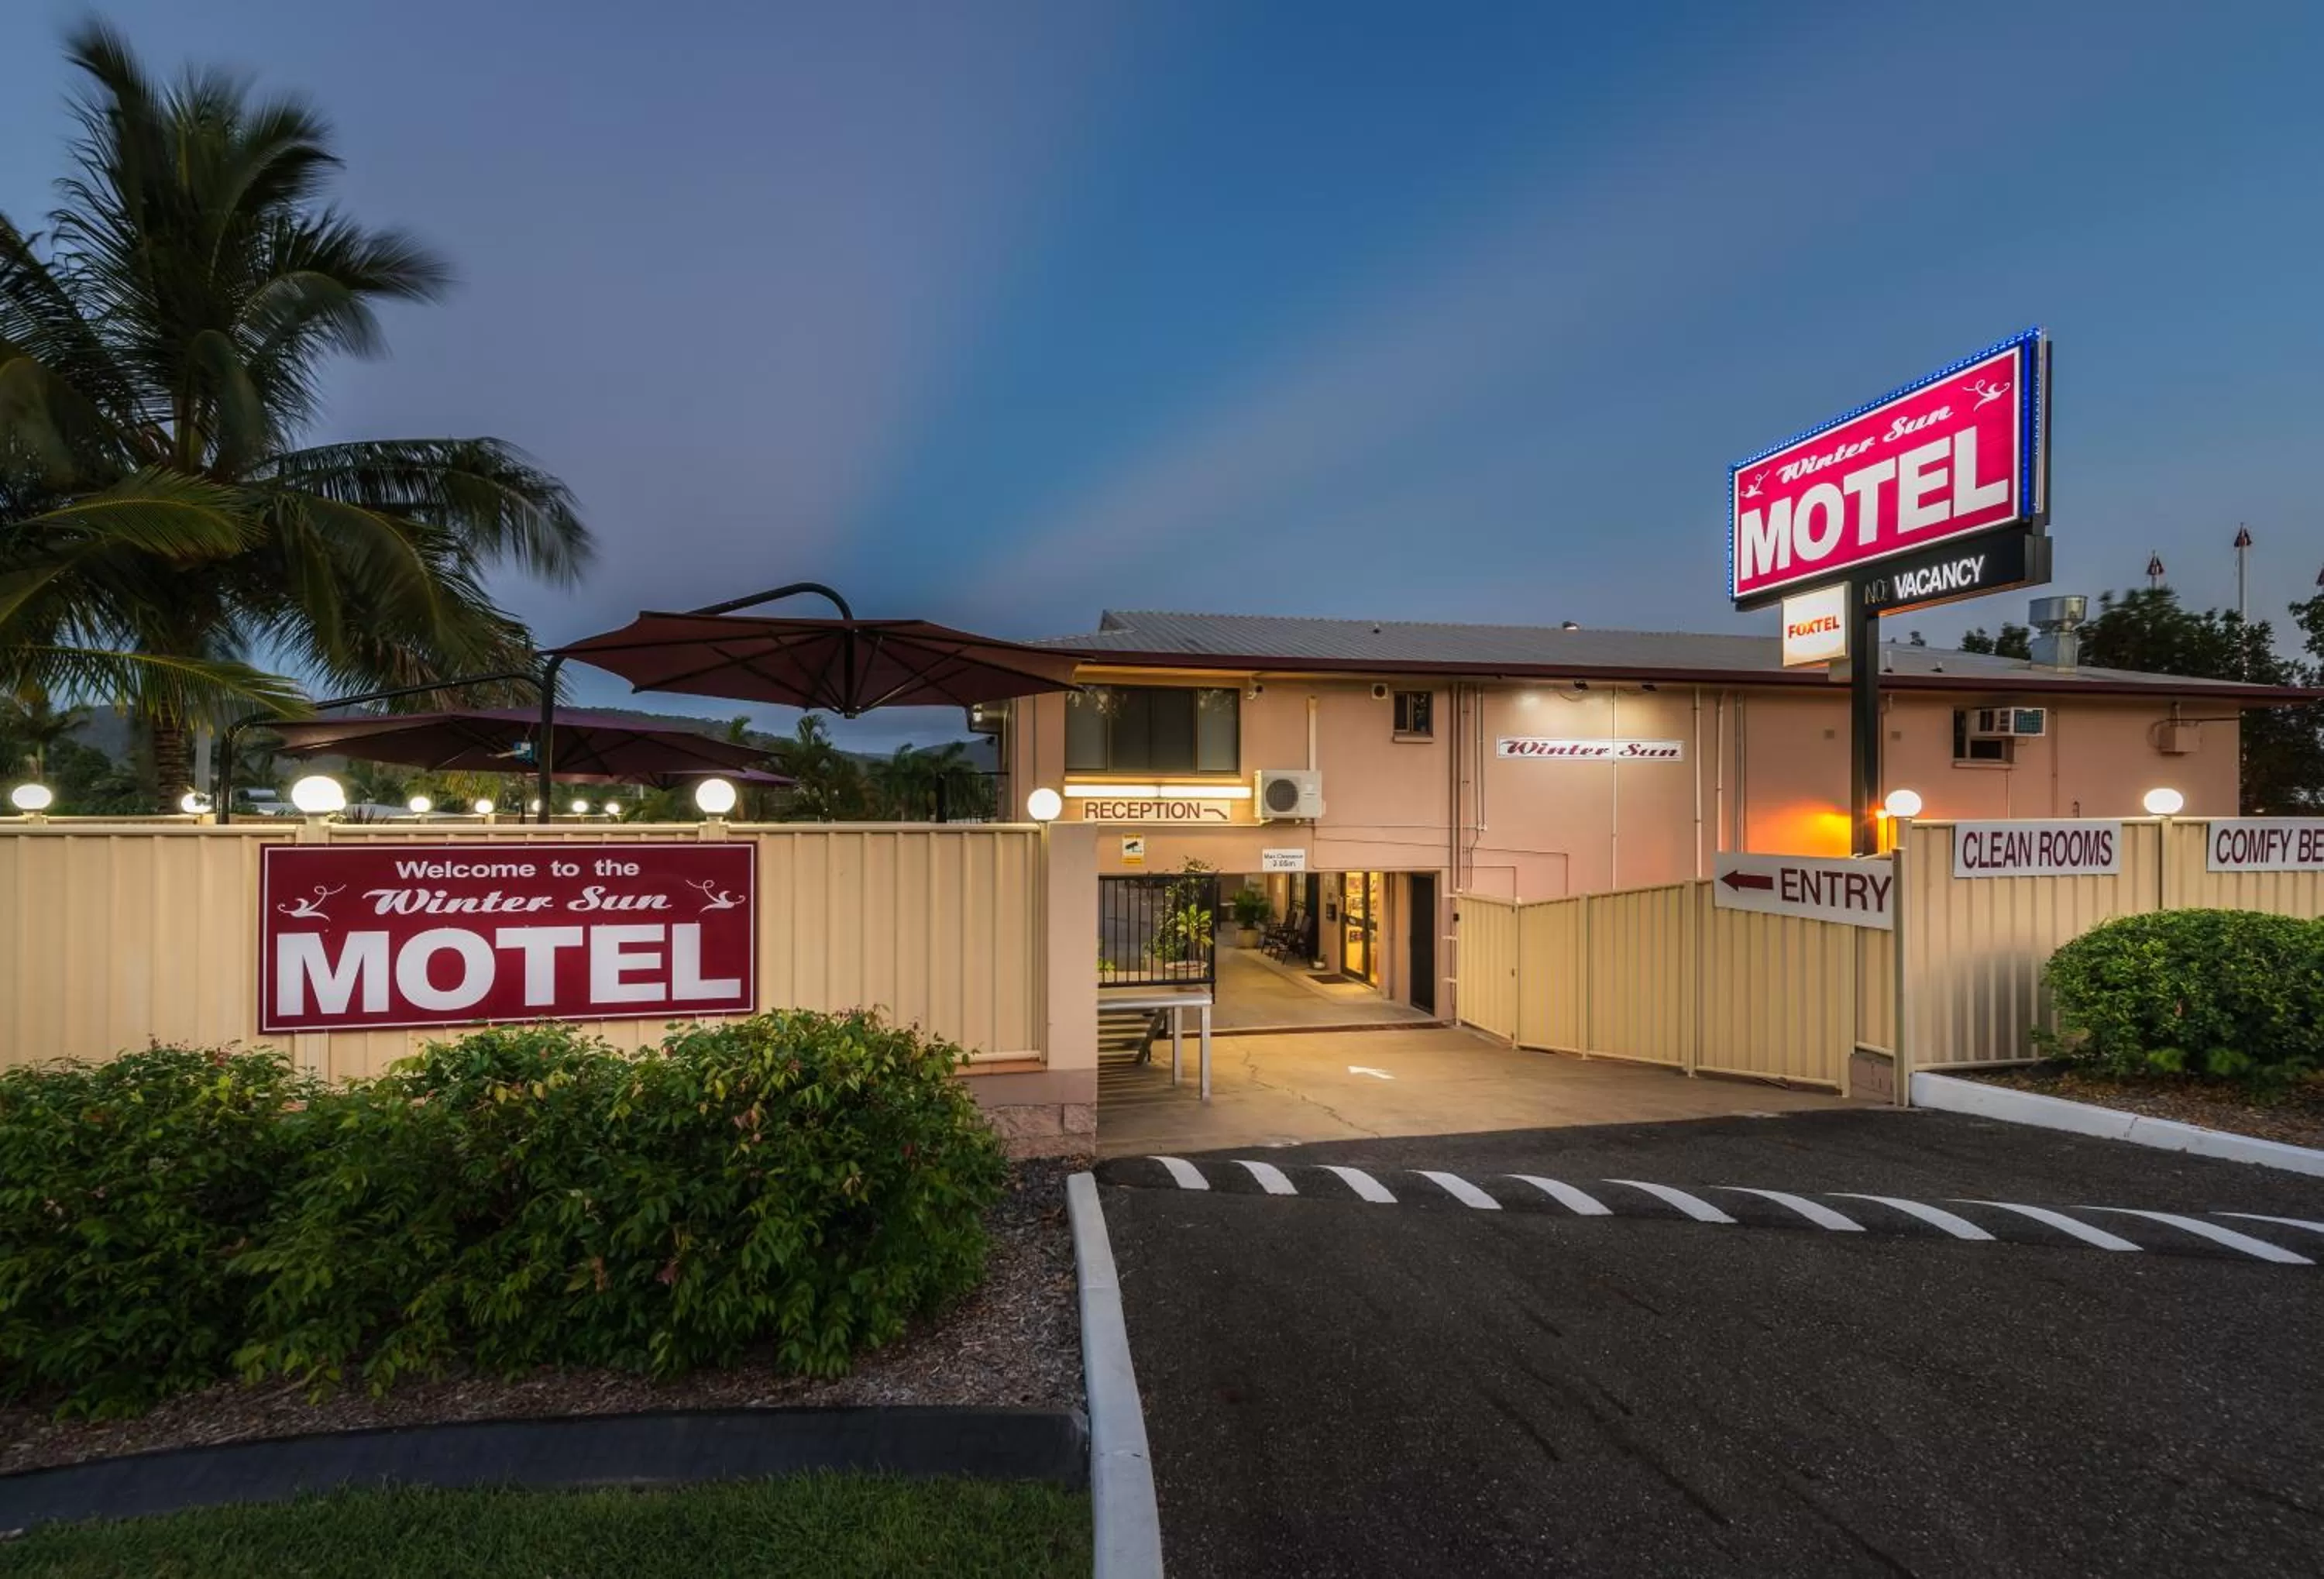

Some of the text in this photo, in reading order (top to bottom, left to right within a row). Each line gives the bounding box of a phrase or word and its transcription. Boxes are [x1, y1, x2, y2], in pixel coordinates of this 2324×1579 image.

[1776, 406, 1954, 484] Winter Sun
[1740, 425, 2009, 581] MOTEL
[1893, 555, 1985, 599] VACANCY
[1788, 616, 1840, 638] FOXTEL
[1501, 740, 1679, 757] Winter Sun
[1085, 802, 1200, 819] RECEPTION
[1962, 830, 2113, 869] CLEAN ROOMS
[2216, 828, 2324, 864] COMFY BE
[396, 859, 640, 879] Welcome to the
[362, 886, 672, 916] Winter Sun
[1780, 867, 1893, 913] ENTRY
[277, 922, 741, 1017] MOTEL
